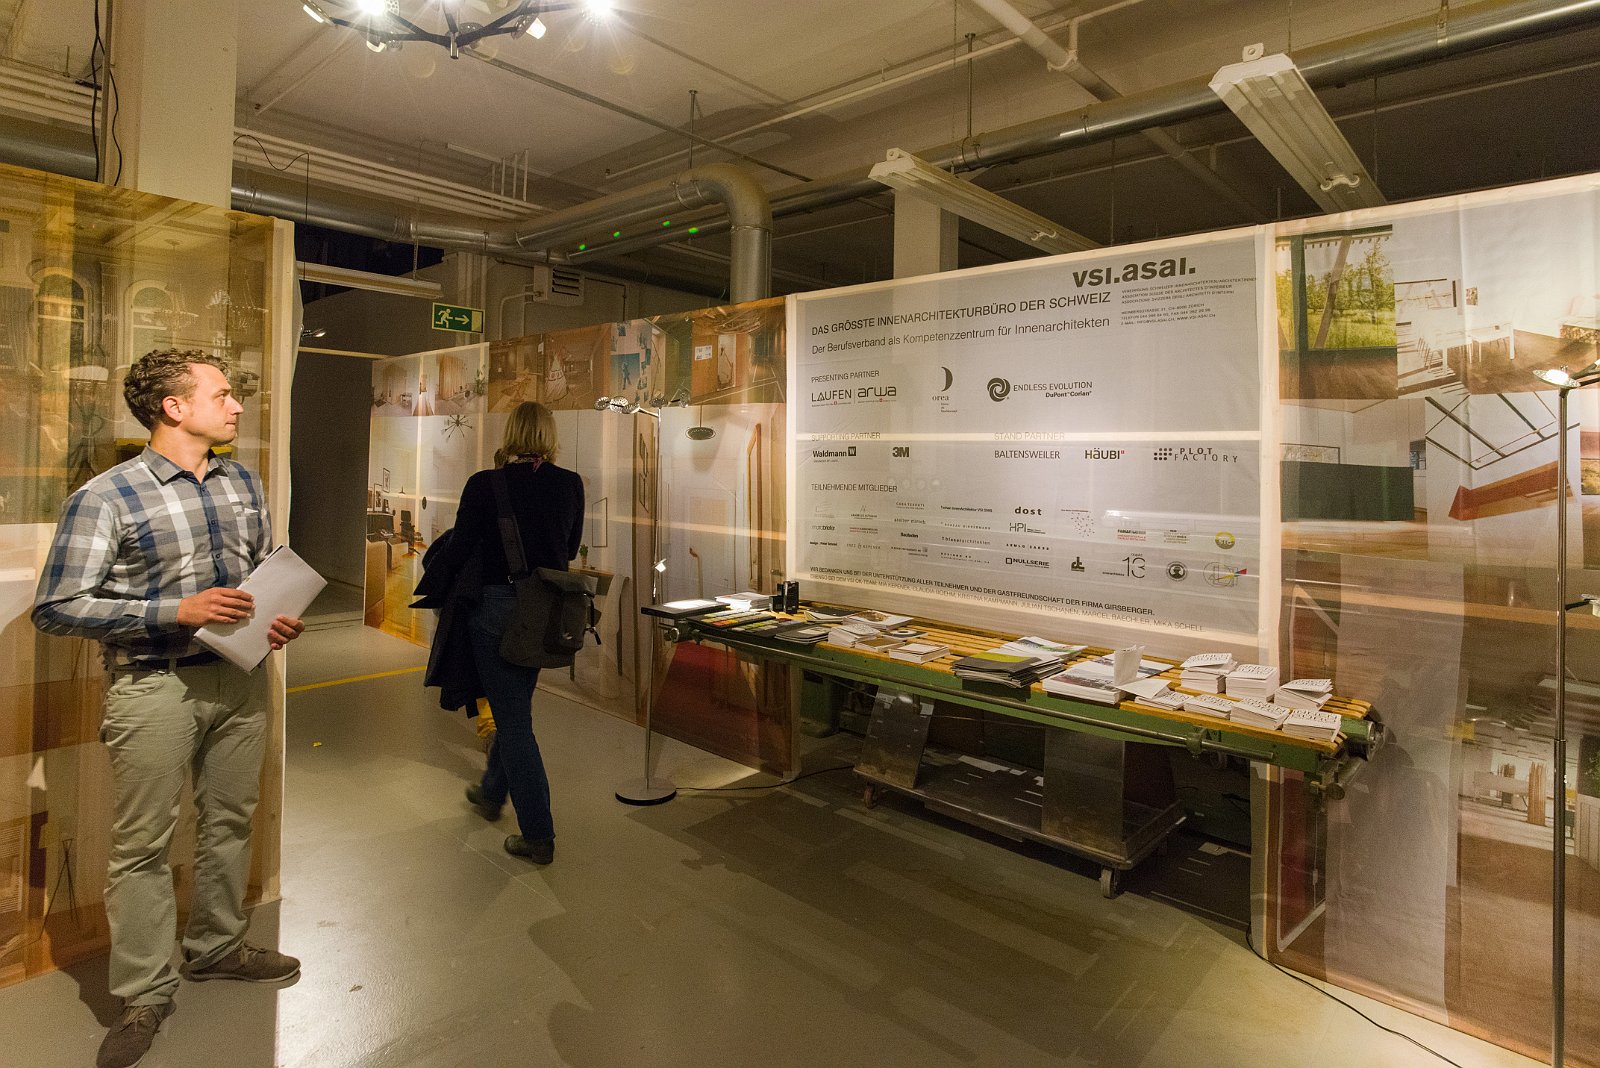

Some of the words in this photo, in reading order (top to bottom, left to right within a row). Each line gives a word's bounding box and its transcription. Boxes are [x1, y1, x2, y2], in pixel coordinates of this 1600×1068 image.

[811, 325, 829, 336] DAS
[831, 317, 875, 333] GRÖSSTE
[877, 302, 1016, 327] INNENARCHITEKTURBÜRO
[1019, 300, 1045, 312] DER
[1049, 291, 1111, 309] SCHWEIZ
[812, 345, 826, 355] Der
[827, 337, 886, 353] Berufsverband
[888, 336, 901, 346] als
[903, 327, 995, 346] Kompetenzzentrum
[998, 325, 1011, 337] für
[1015, 317, 1110, 335] Innenarchitekten
[811, 373, 849, 384] PRESENTING
[850, 370, 880, 379] PARTNER
[1013, 384, 1048, 392] ENDLESS
[1049, 381, 1093, 391] EVOLUTION
[811, 388, 852, 403] LAUFEN
[858, 386, 897, 398] arwa
[851, 431, 881, 440] PARTNER
[994, 432, 1022, 440] STAND
[1024, 432, 1065, 440] PARTNER
[812, 450, 847, 458] Waldmann
[892, 446, 910, 458] 3M
[994, 450, 1061, 460] BALTENSWEILER
[1179, 447, 1214, 456] PLOT
[1174, 453, 1239, 463] FACTORY
[858, 484, 898, 493] MITGLIEDER
[1014, 506, 1042, 516] dost
[1013, 558, 1050, 567] NULLSERIE
[873, 572, 916, 584] UNTERSTÜTZUNG
[916, 578, 934, 586] ALLER
[934, 581, 969, 591] TEILNEHMER
[997, 589, 1064, 604] GASTFREUNDSCHAFT
[1066, 598, 1081, 606] DER
[1082, 600, 1104, 610] FIRMA
[1105, 603, 1155, 616] GIRSBERGER.
[1021, 600, 1043, 611] JULIAN
